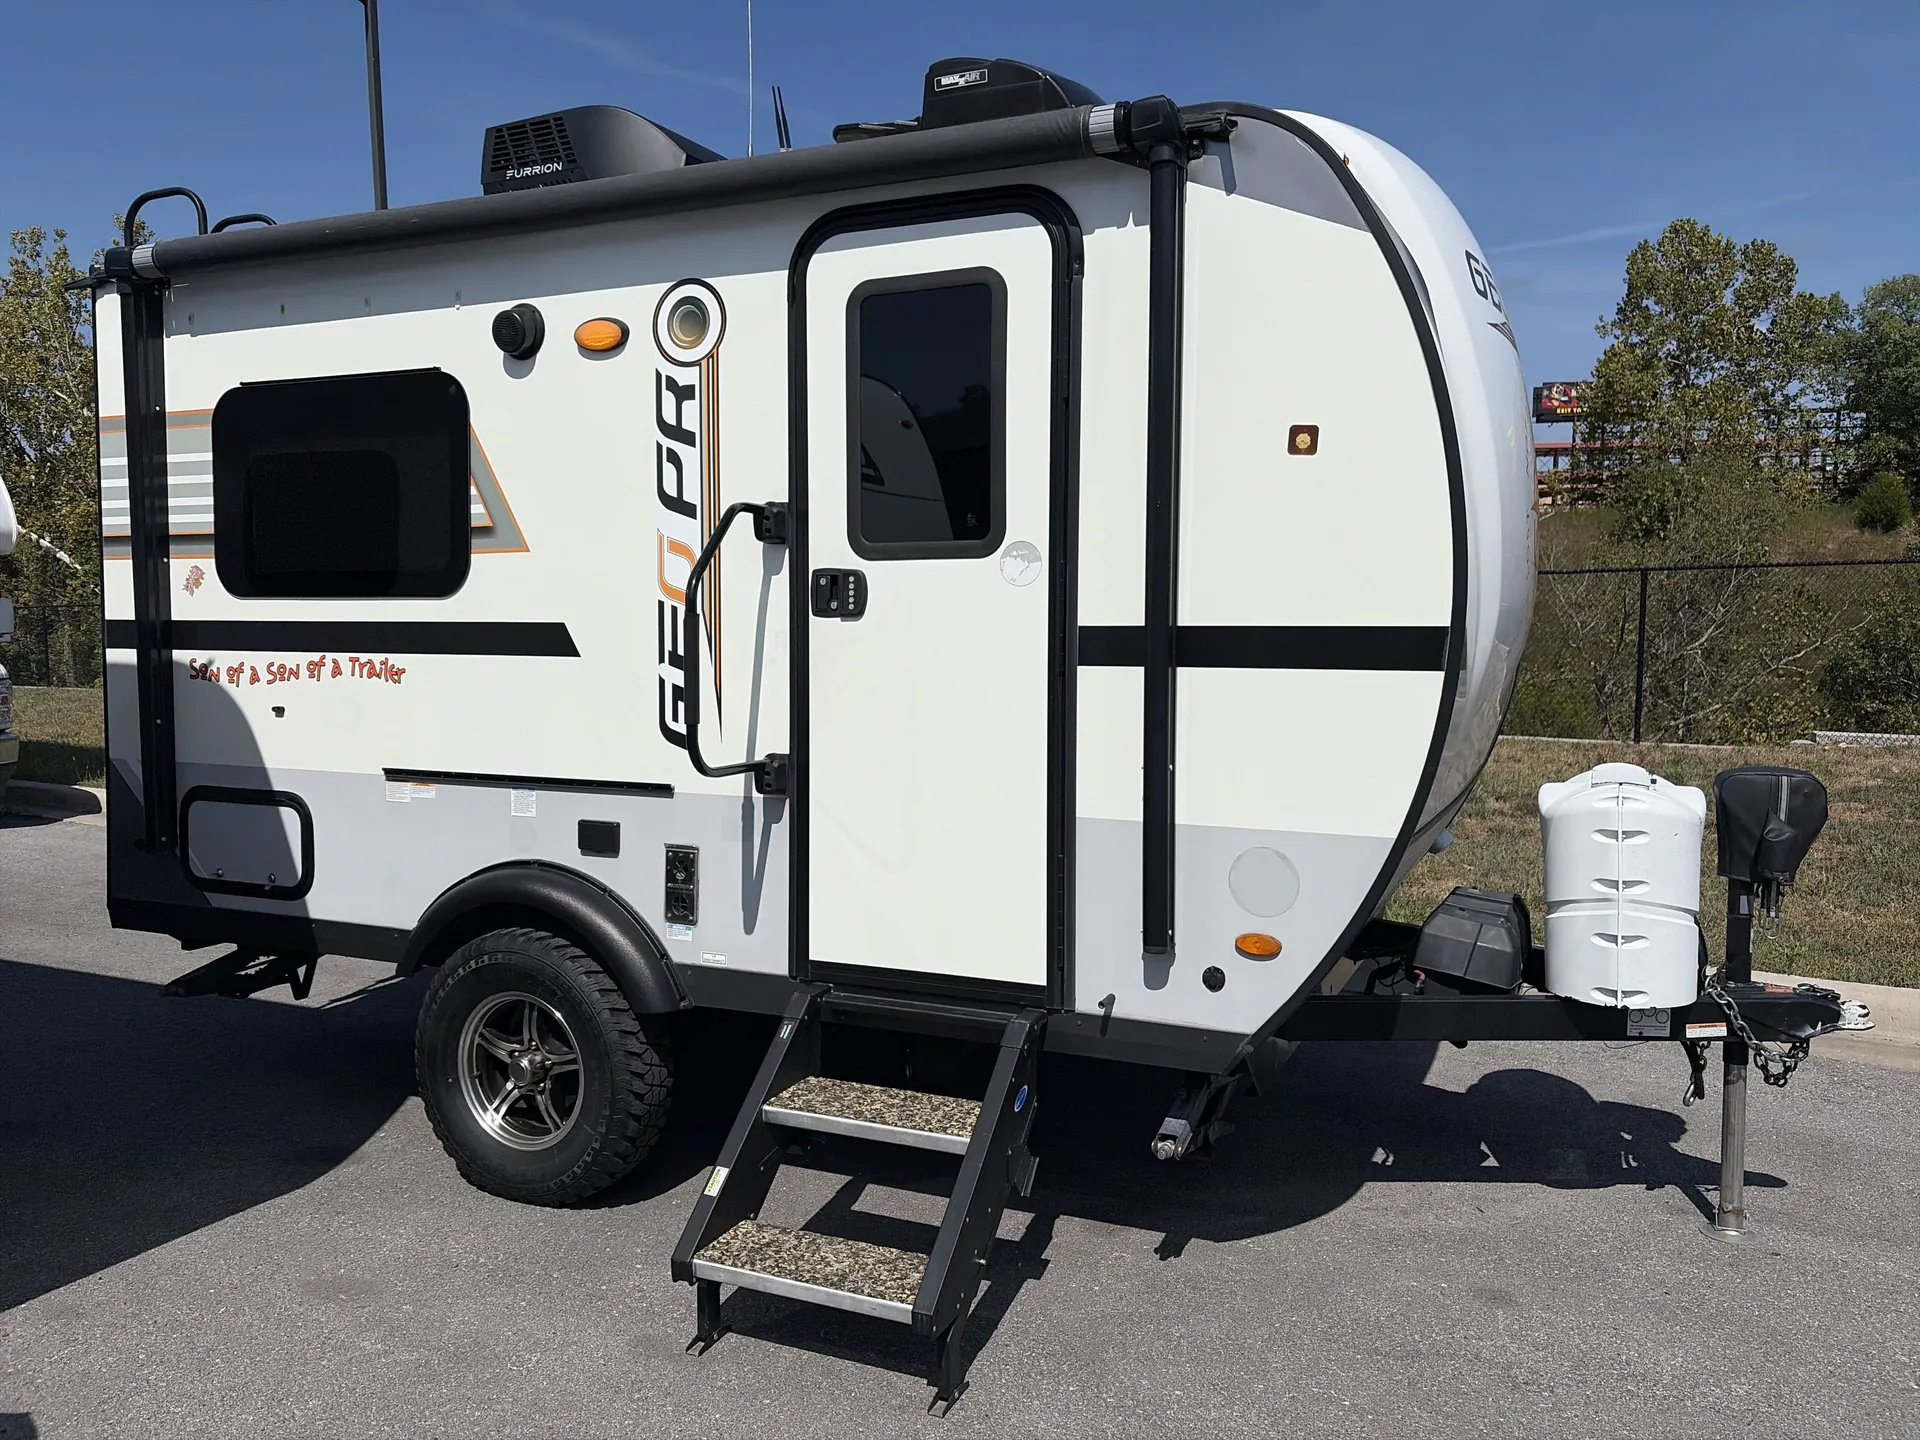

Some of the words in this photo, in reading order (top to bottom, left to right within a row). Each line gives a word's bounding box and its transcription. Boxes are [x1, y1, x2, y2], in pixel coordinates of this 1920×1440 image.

[505, 161, 563, 180] FURRION
[1464, 249, 1503, 314] GE
[226, 661, 245, 688] of
[249, 665, 261, 686] a
[306, 654, 326, 682] of
[331, 657, 343, 679] a
